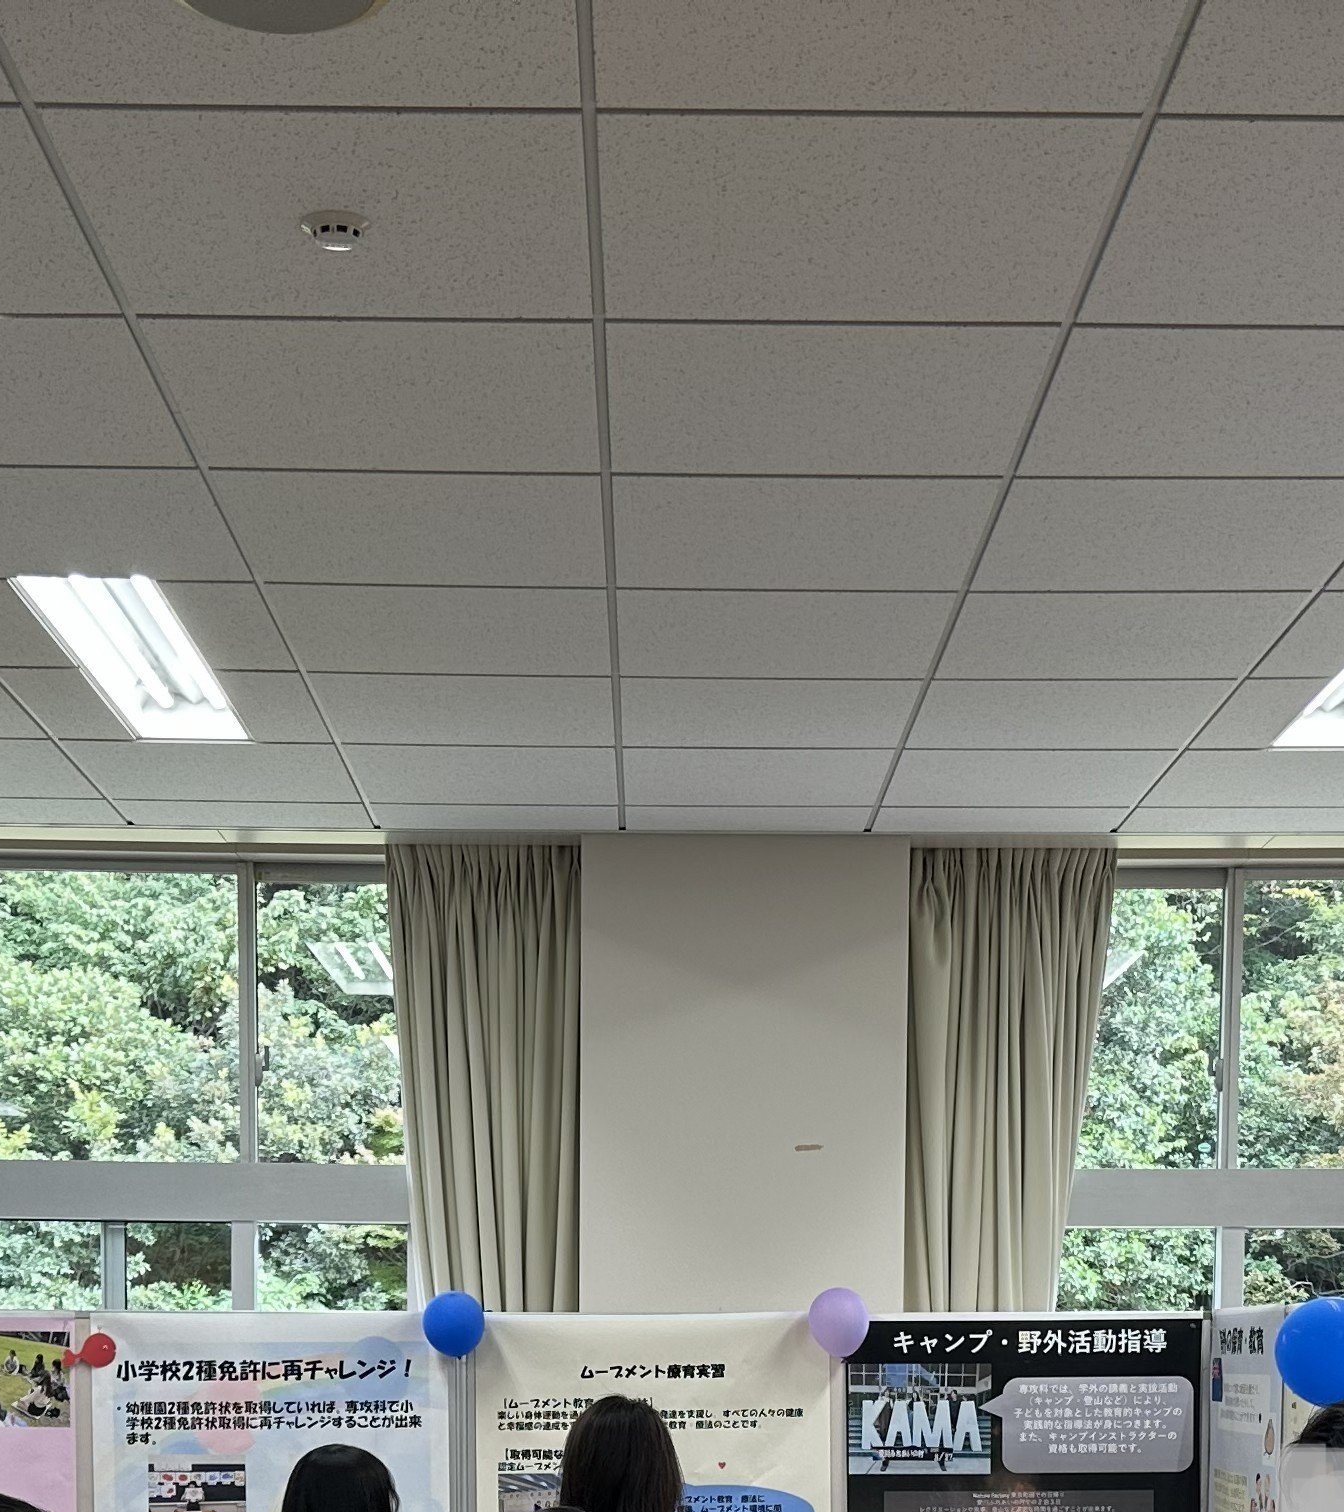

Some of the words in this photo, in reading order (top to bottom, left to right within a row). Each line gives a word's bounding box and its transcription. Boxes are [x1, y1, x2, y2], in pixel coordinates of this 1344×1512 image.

[893, 1329, 1167, 1354] キャンプ・野外活動指導
[126, 1432, 157, 1446] ます。
